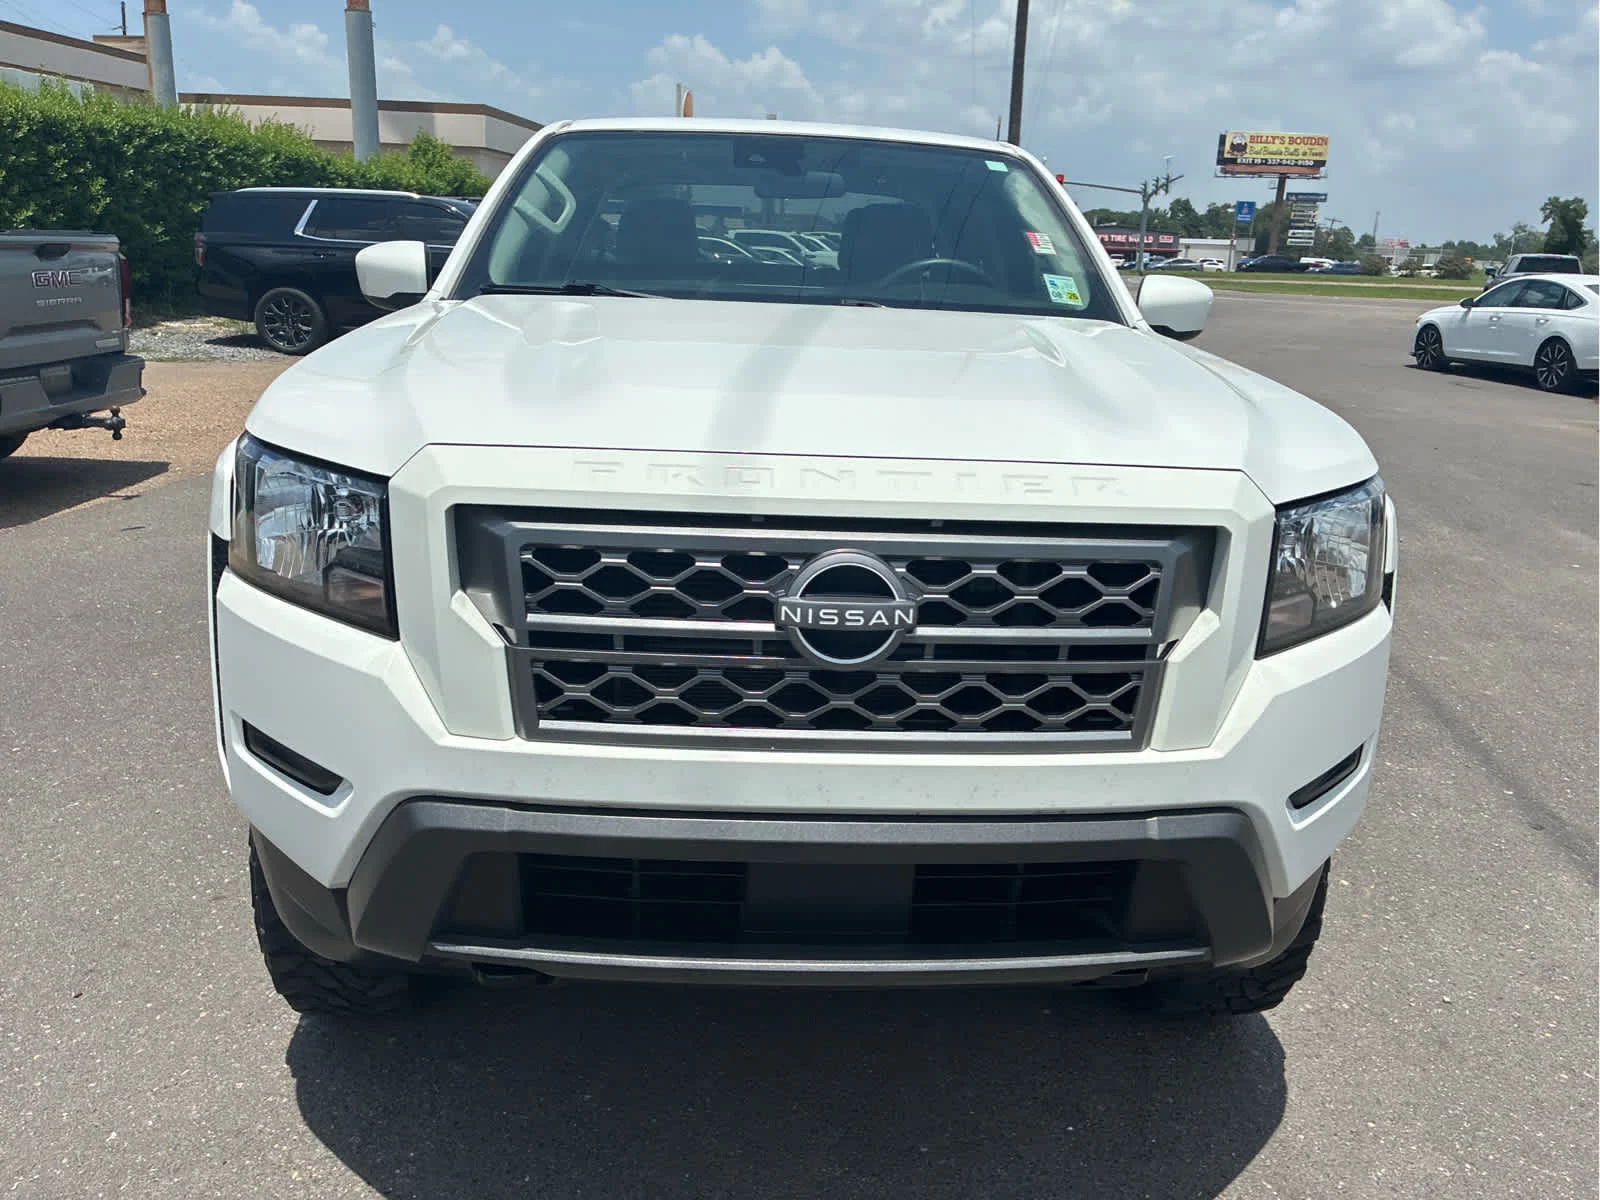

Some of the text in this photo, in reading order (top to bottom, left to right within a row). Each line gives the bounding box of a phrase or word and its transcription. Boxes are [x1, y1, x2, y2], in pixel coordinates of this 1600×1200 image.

[1248, 135, 1329, 146] BILLY'S BOUDIN
[1110, 234, 1128, 242] TIRE
[1128, 234, 1154, 243] WOLD
[32, 269, 82, 288] GMC
[36, 297, 82, 306] SIERRA
[571, 460, 1130, 498] FRONTIER
[780, 606, 914, 626] NISSAN
